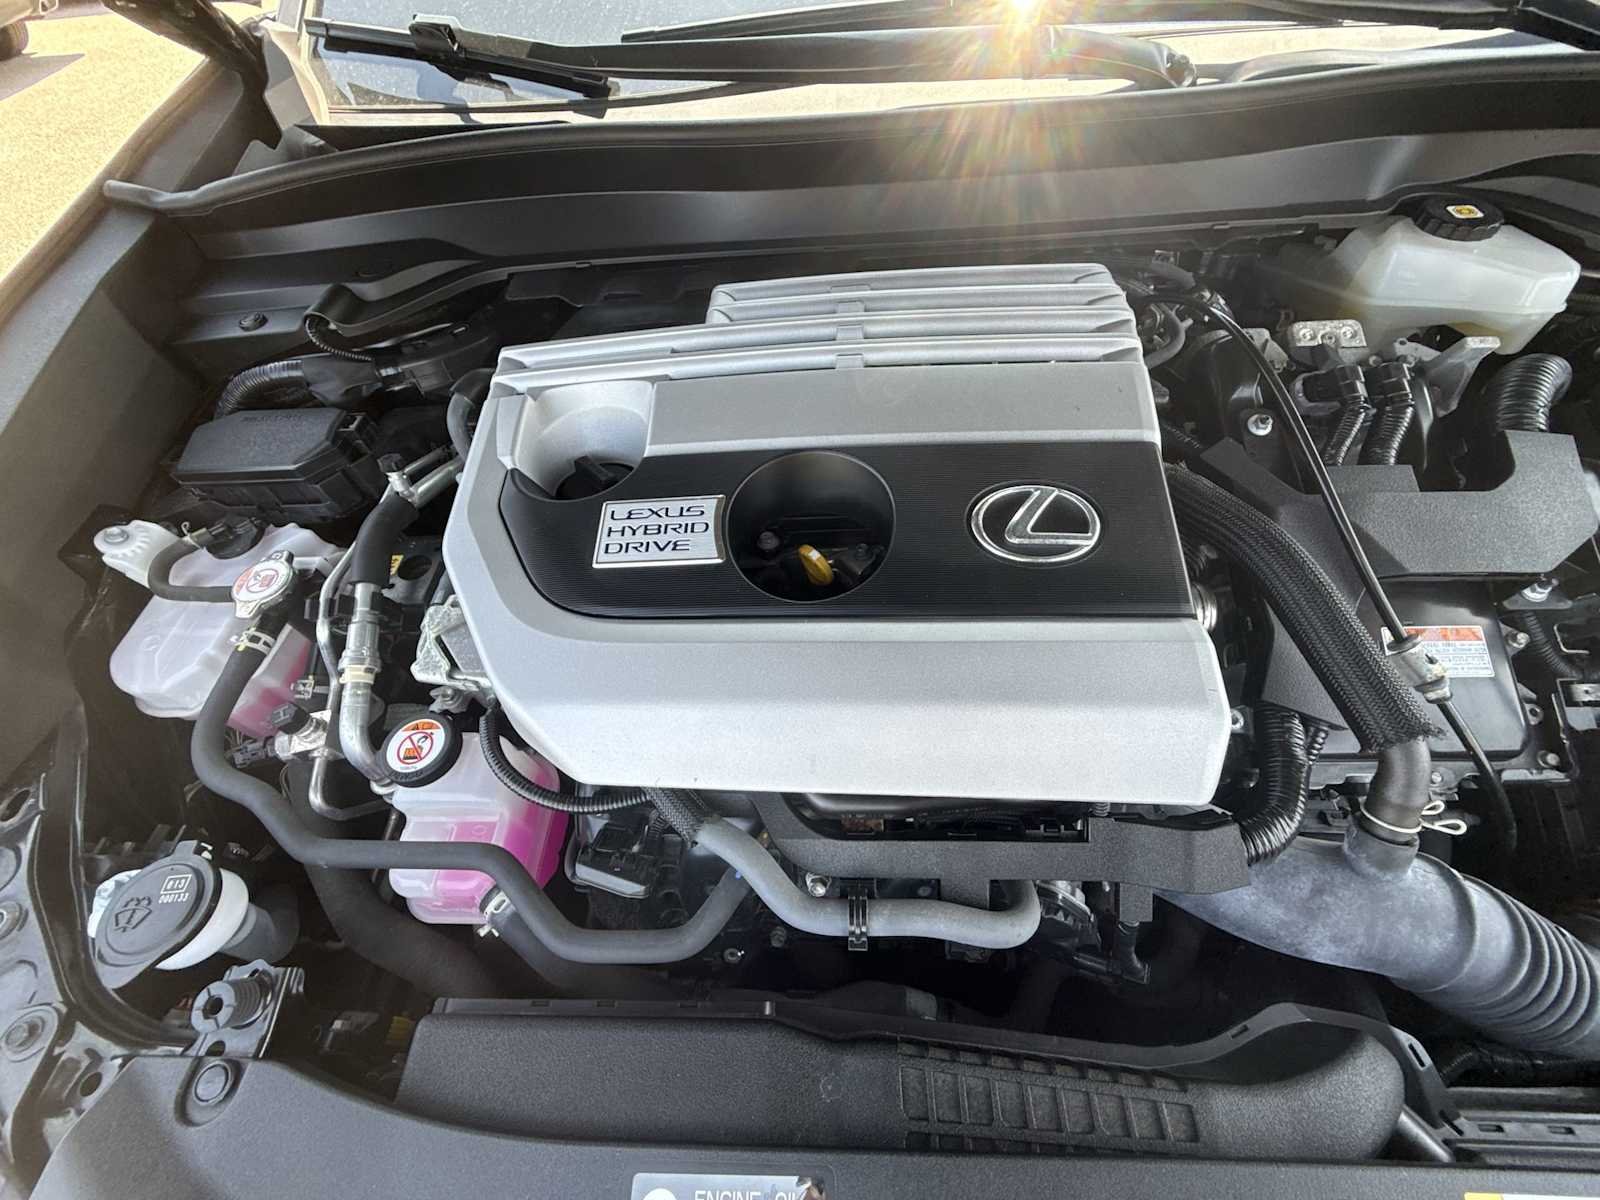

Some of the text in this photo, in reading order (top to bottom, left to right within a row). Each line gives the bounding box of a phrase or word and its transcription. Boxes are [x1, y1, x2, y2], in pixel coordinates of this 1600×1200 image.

[610, 505, 705, 521] LEXUS
[607, 521, 709, 538] HYBRID
[604, 539, 691, 554] DRIVE
